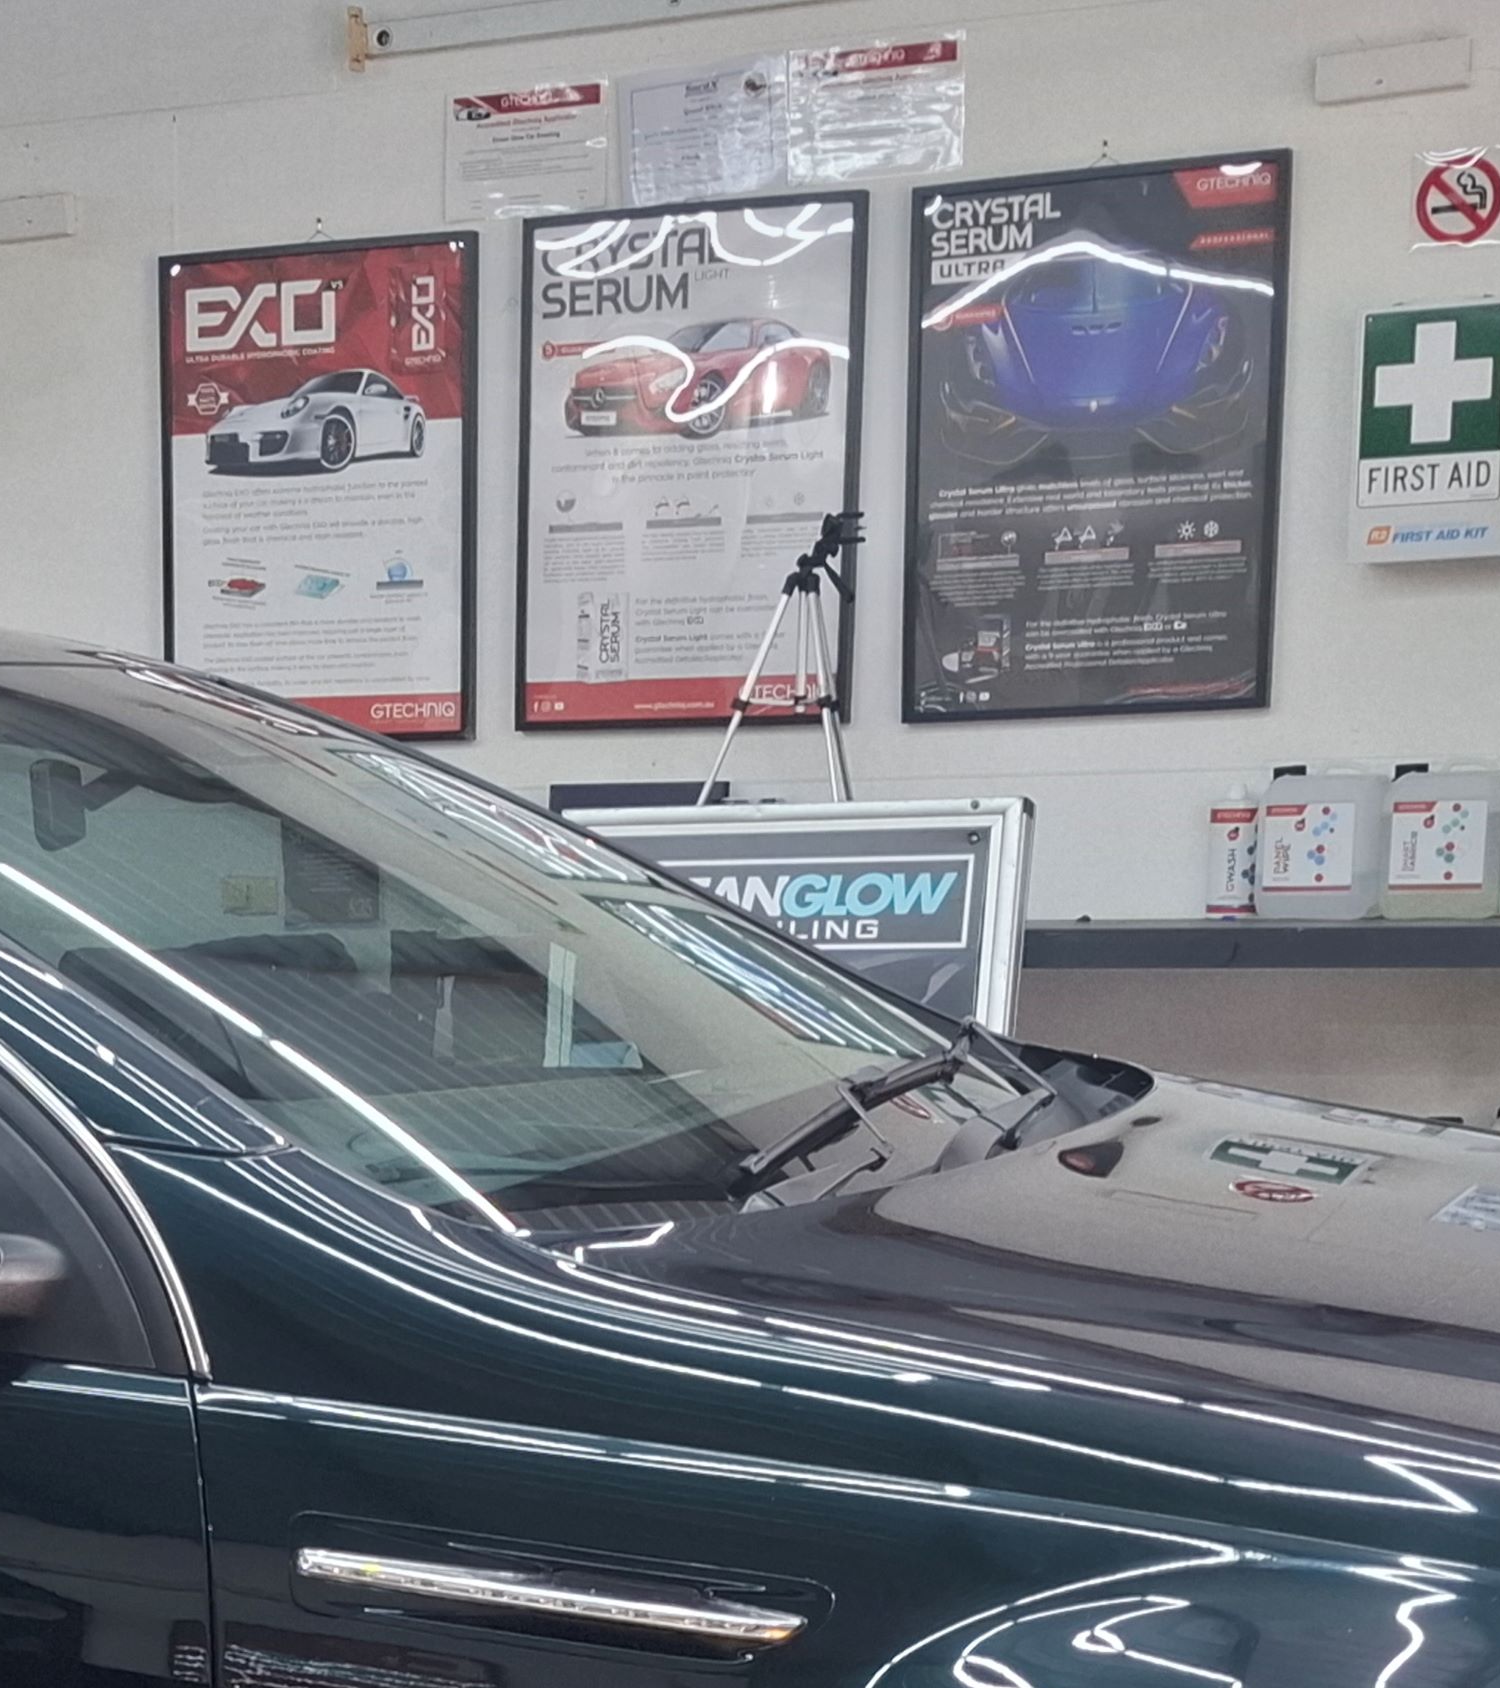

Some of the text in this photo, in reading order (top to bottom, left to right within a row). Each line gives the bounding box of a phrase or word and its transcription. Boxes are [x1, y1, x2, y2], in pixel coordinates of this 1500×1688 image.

[931, 192, 1062, 230] CRYSTAL
[931, 222, 1034, 257] SERUM
[693, 267, 731, 283] LIGHT
[411, 275, 435, 352] EXO
[541, 272, 690, 320] SERUM
[184, 278, 337, 353] EXO
[1367, 460, 1492, 495] FIRST AID
[1392, 529, 1434, 544] FIRST
[1435, 528, 1461, 541] AID
[1463, 526, 1490, 539] KIT
[369, 701, 456, 720] GTECHNIQ
[688, 871, 958, 919] ANGLOW
[776, 919, 880, 940] LING
